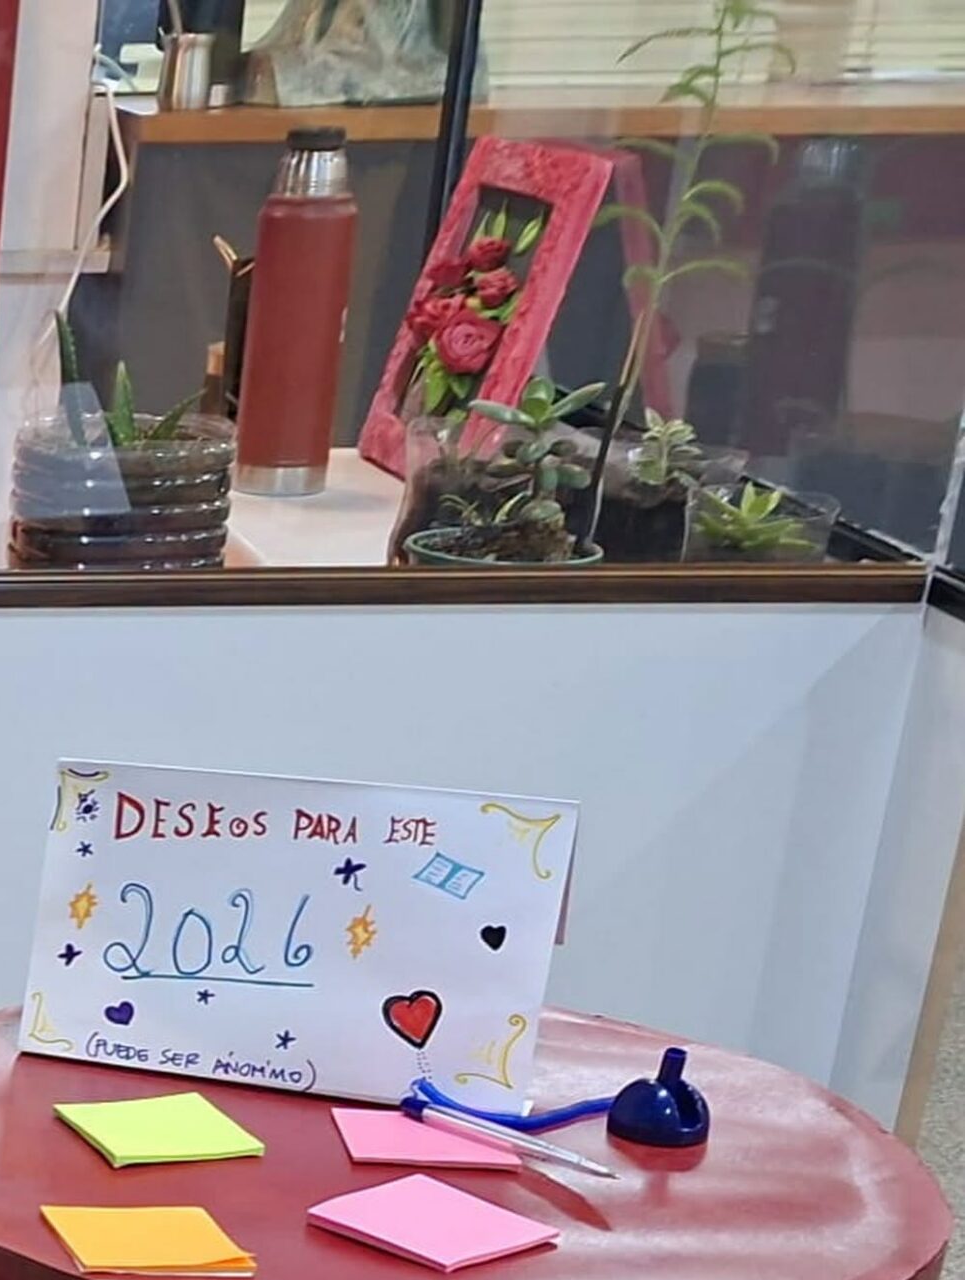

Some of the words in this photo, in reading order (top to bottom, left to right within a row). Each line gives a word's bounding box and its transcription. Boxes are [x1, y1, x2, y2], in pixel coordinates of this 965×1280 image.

[292, 808, 358, 845] PARA
[384, 815, 438, 847] ESTE
[102, 881, 315, 978] 2026
[159, 1048, 201, 1069] SER
